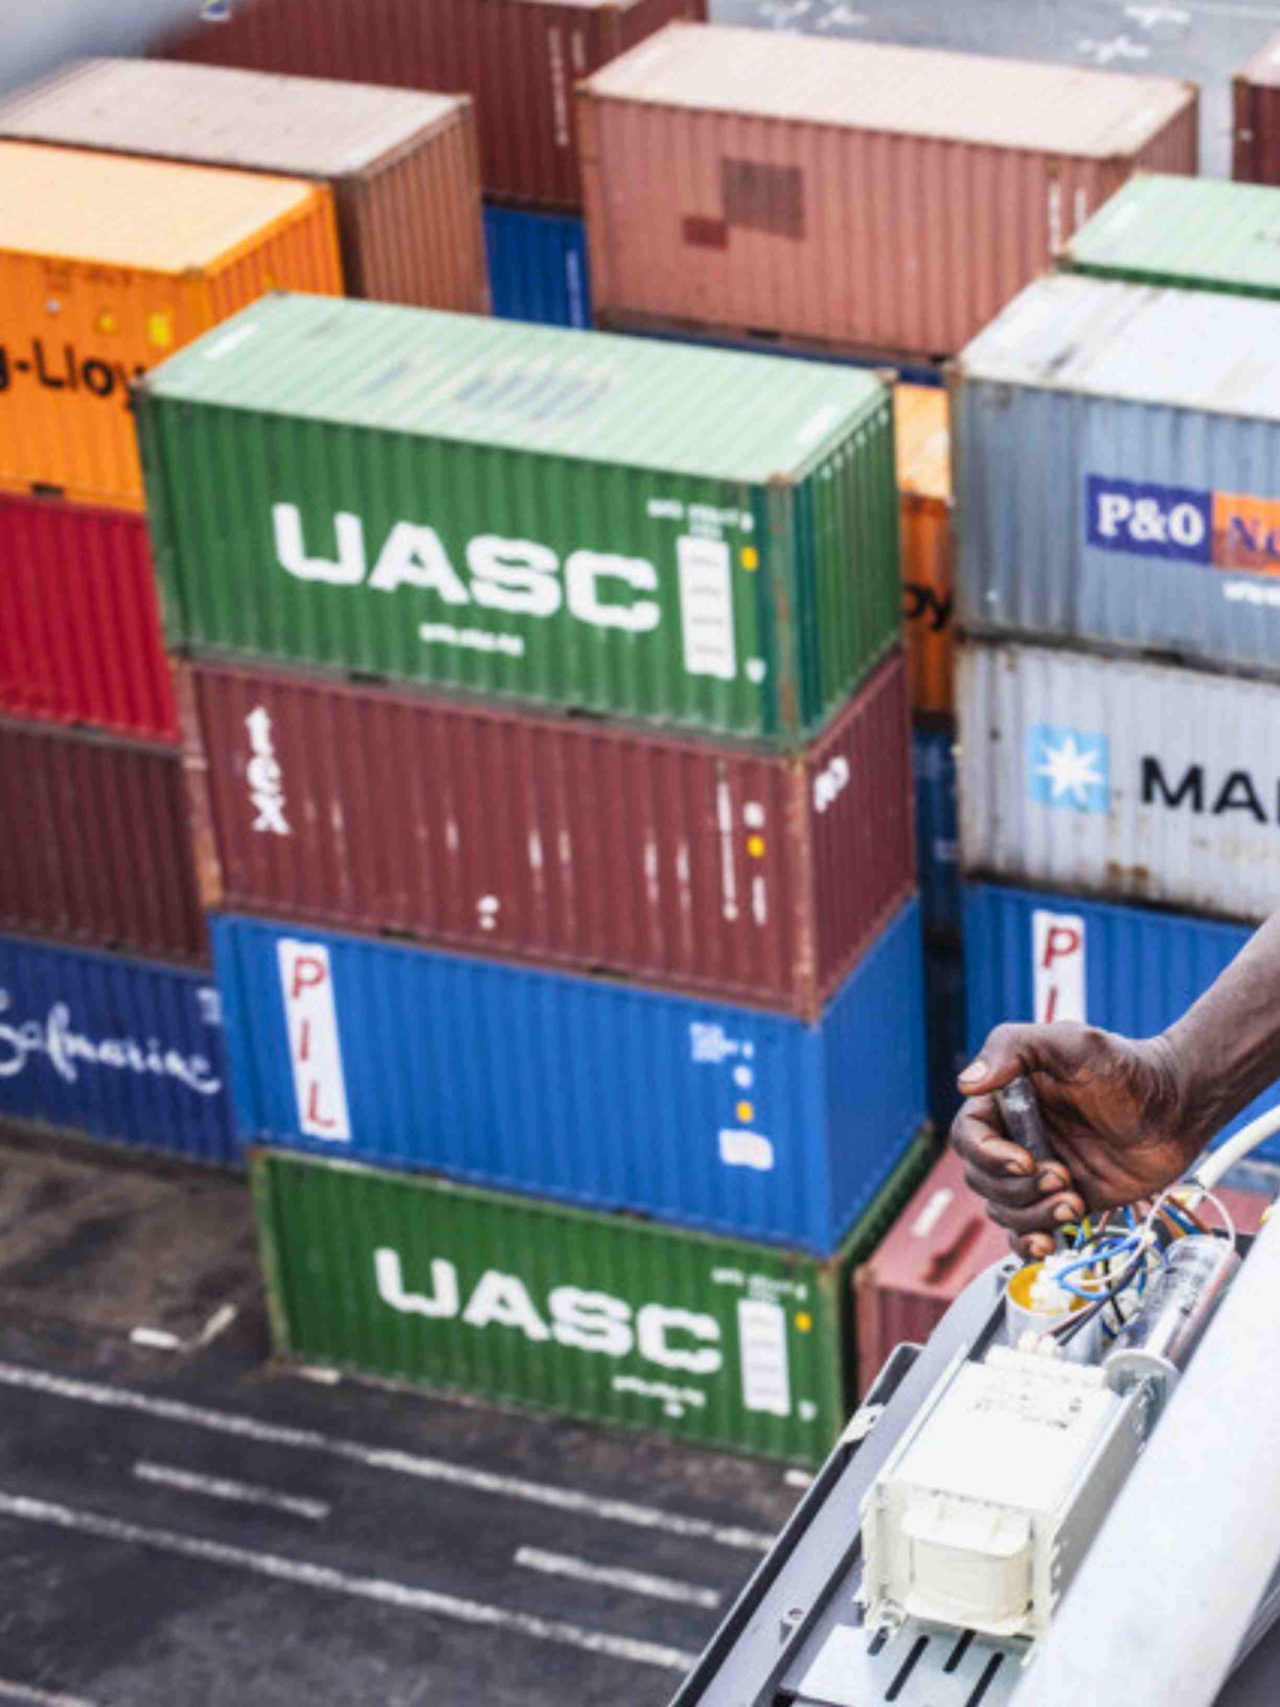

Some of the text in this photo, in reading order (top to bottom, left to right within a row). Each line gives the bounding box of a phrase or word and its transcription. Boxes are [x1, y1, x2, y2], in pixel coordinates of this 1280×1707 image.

[272, 502, 661, 631] UASC
[1096, 493, 1205, 547] P&O
[291, 956, 336, 1128] PIL
[373, 1247, 723, 1374] UASC
